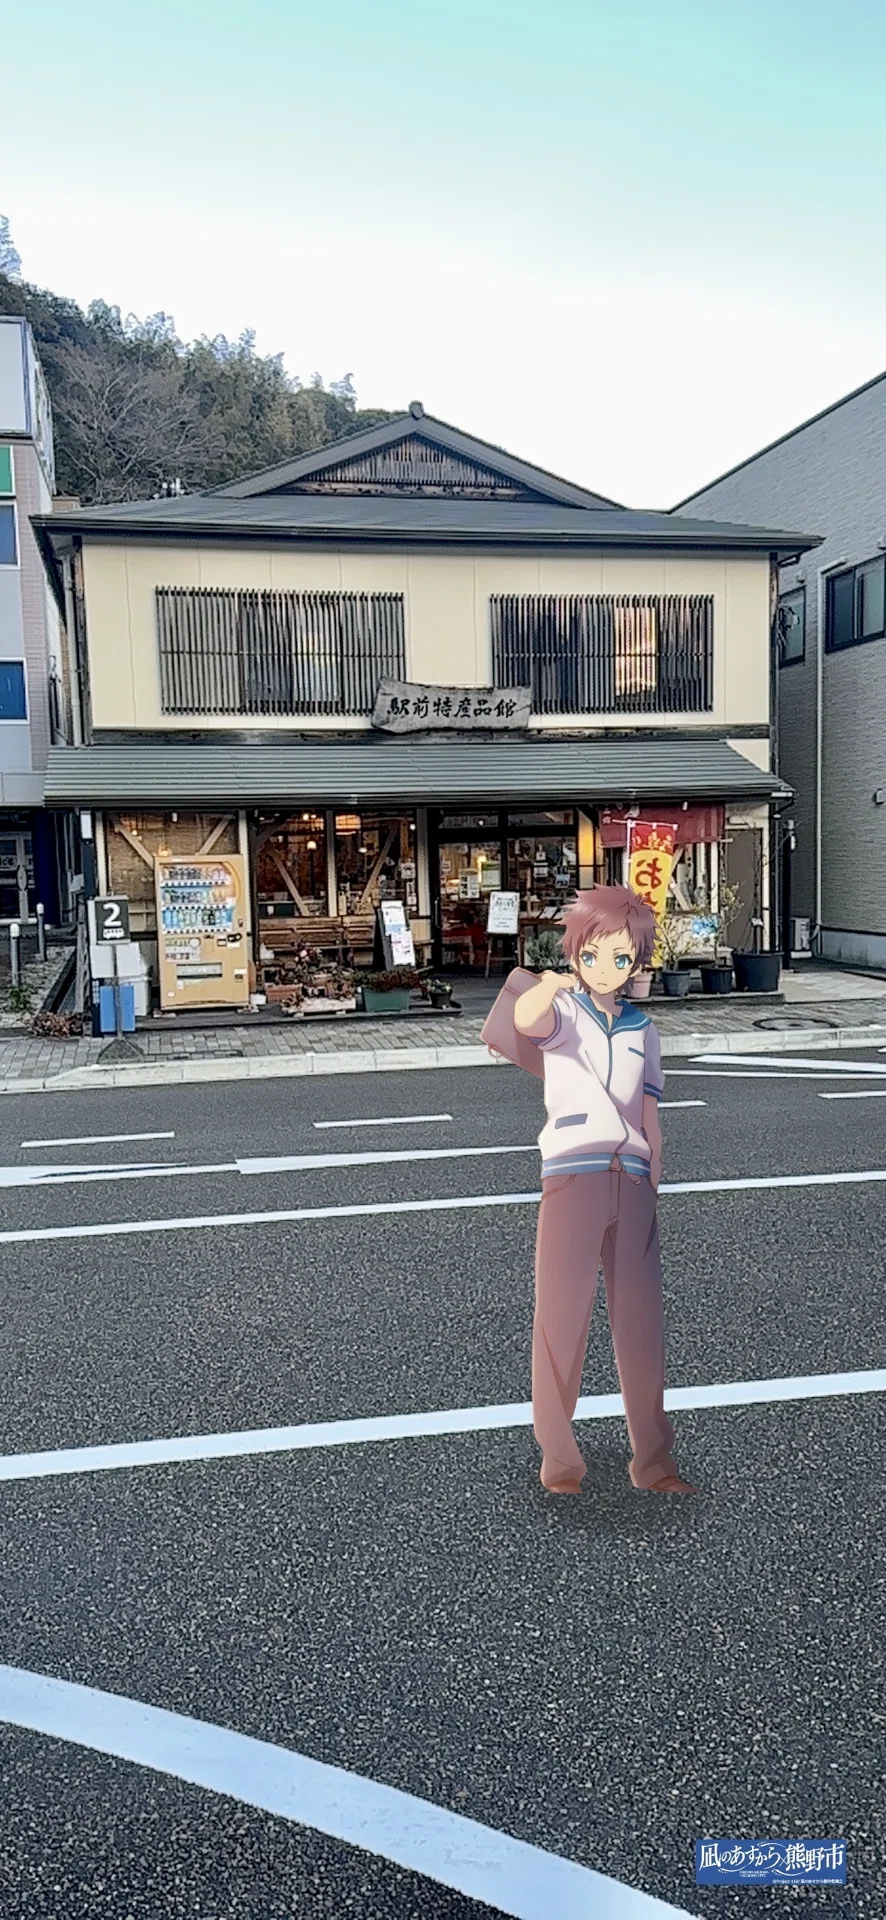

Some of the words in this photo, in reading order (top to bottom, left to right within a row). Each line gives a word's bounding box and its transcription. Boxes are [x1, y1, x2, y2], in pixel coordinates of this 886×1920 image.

[387, 696, 517, 718] 駅前特産品館
[103, 902, 122, 927] 2
